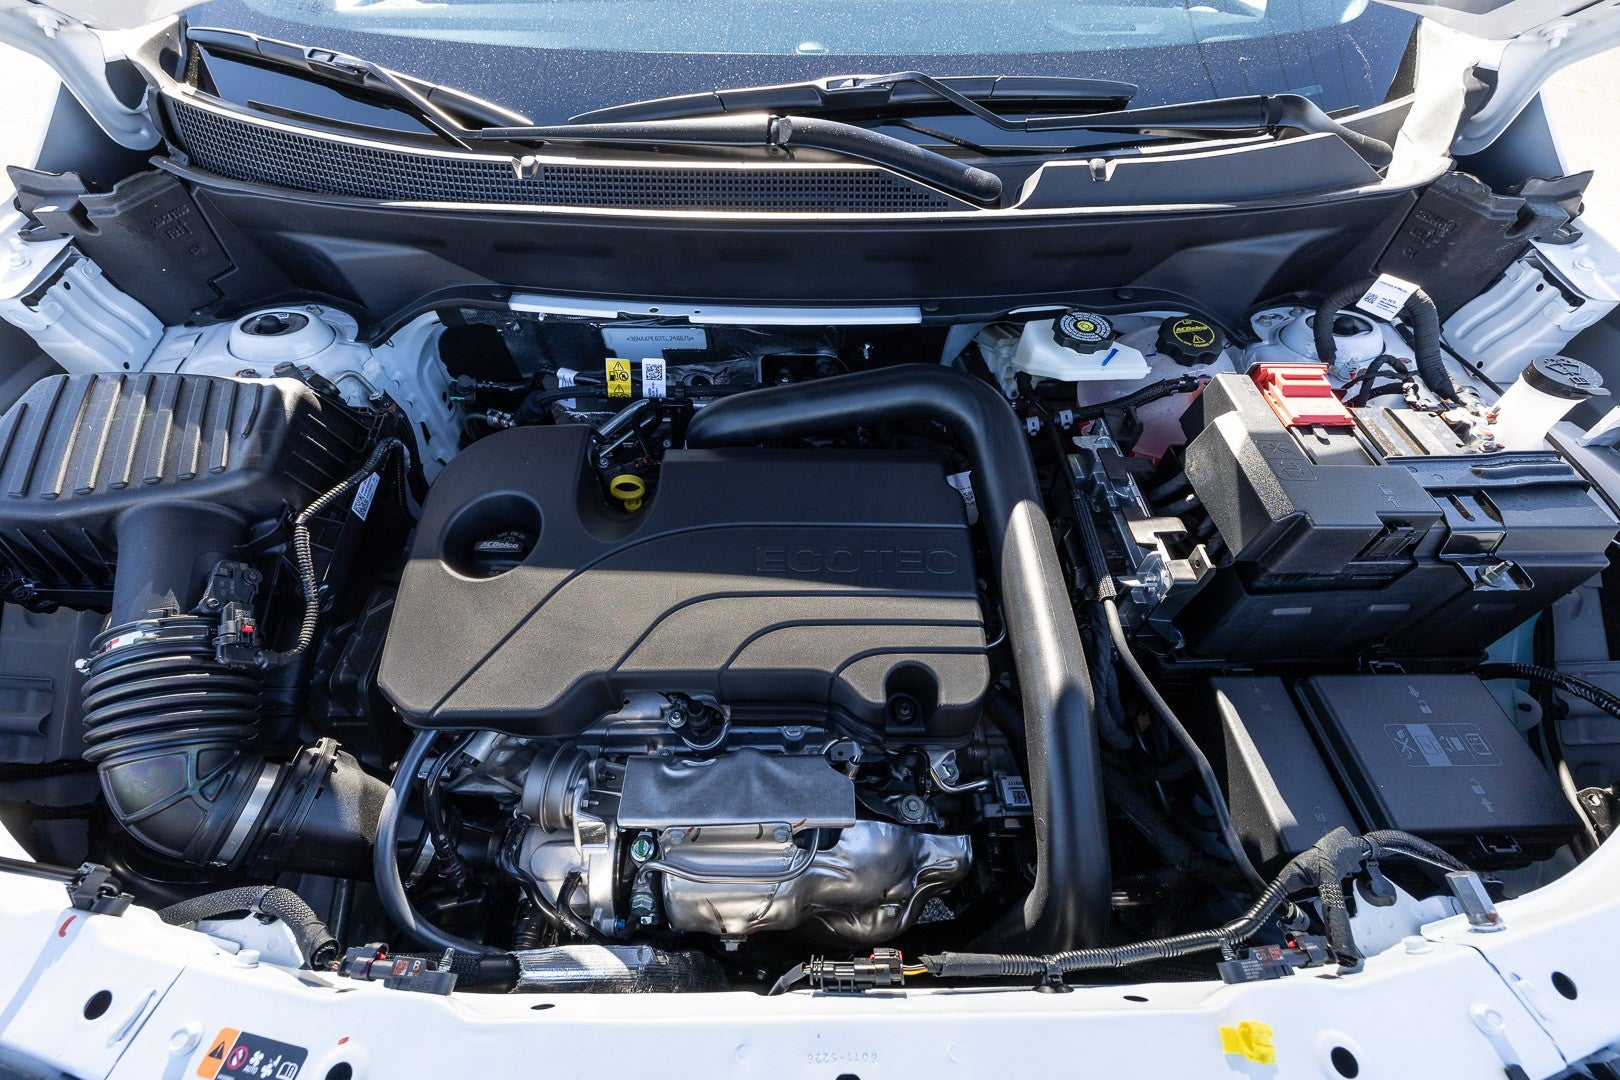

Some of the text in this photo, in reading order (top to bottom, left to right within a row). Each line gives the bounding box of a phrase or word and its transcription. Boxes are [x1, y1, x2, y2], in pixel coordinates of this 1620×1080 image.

[478, 541, 520, 549] ACDelco
[755, 546, 960, 575] ECOTEC
[242, 1064, 259, 1075] AUTO
